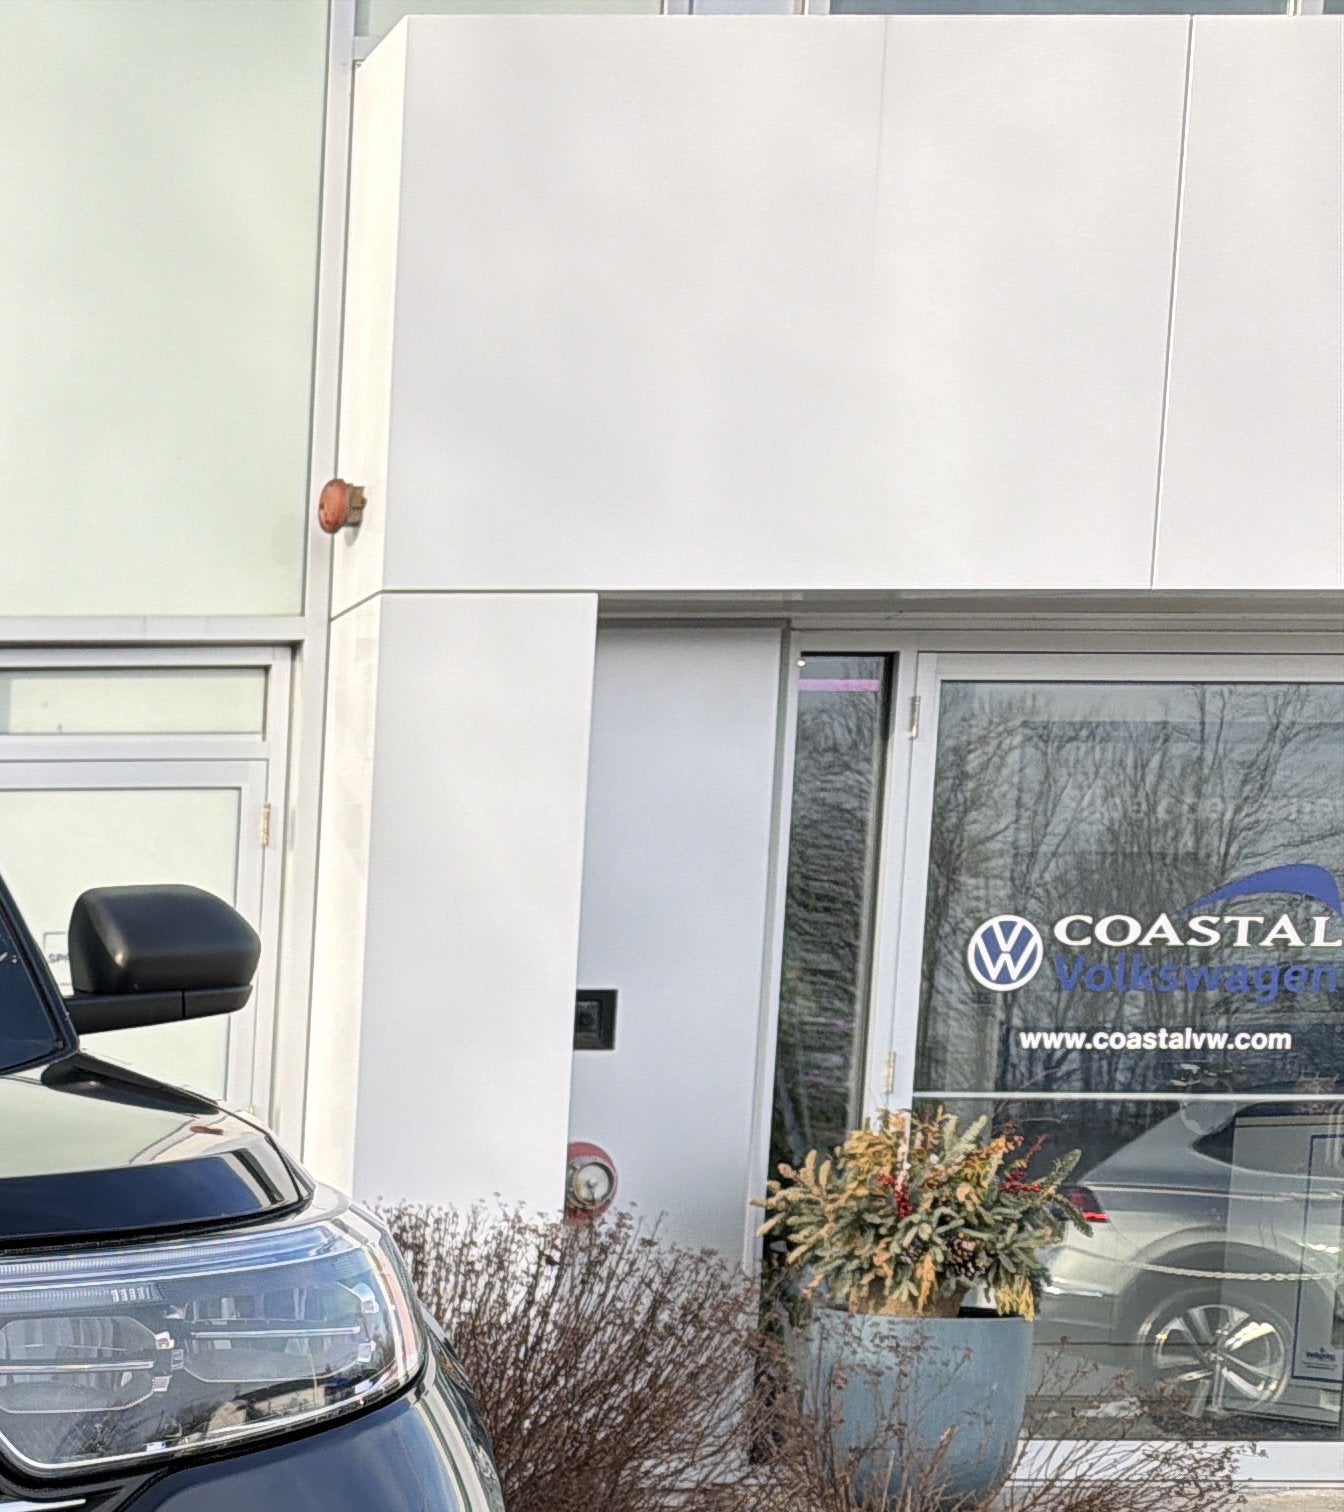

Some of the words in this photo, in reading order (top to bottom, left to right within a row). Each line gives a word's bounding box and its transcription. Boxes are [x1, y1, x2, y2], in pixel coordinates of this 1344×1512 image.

[1053, 912, 1343, 947] COASTAL
[1053, 952, 1338, 1006] Volkswagen
[1018, 1028, 1293, 1051] www.coastalvw.com
